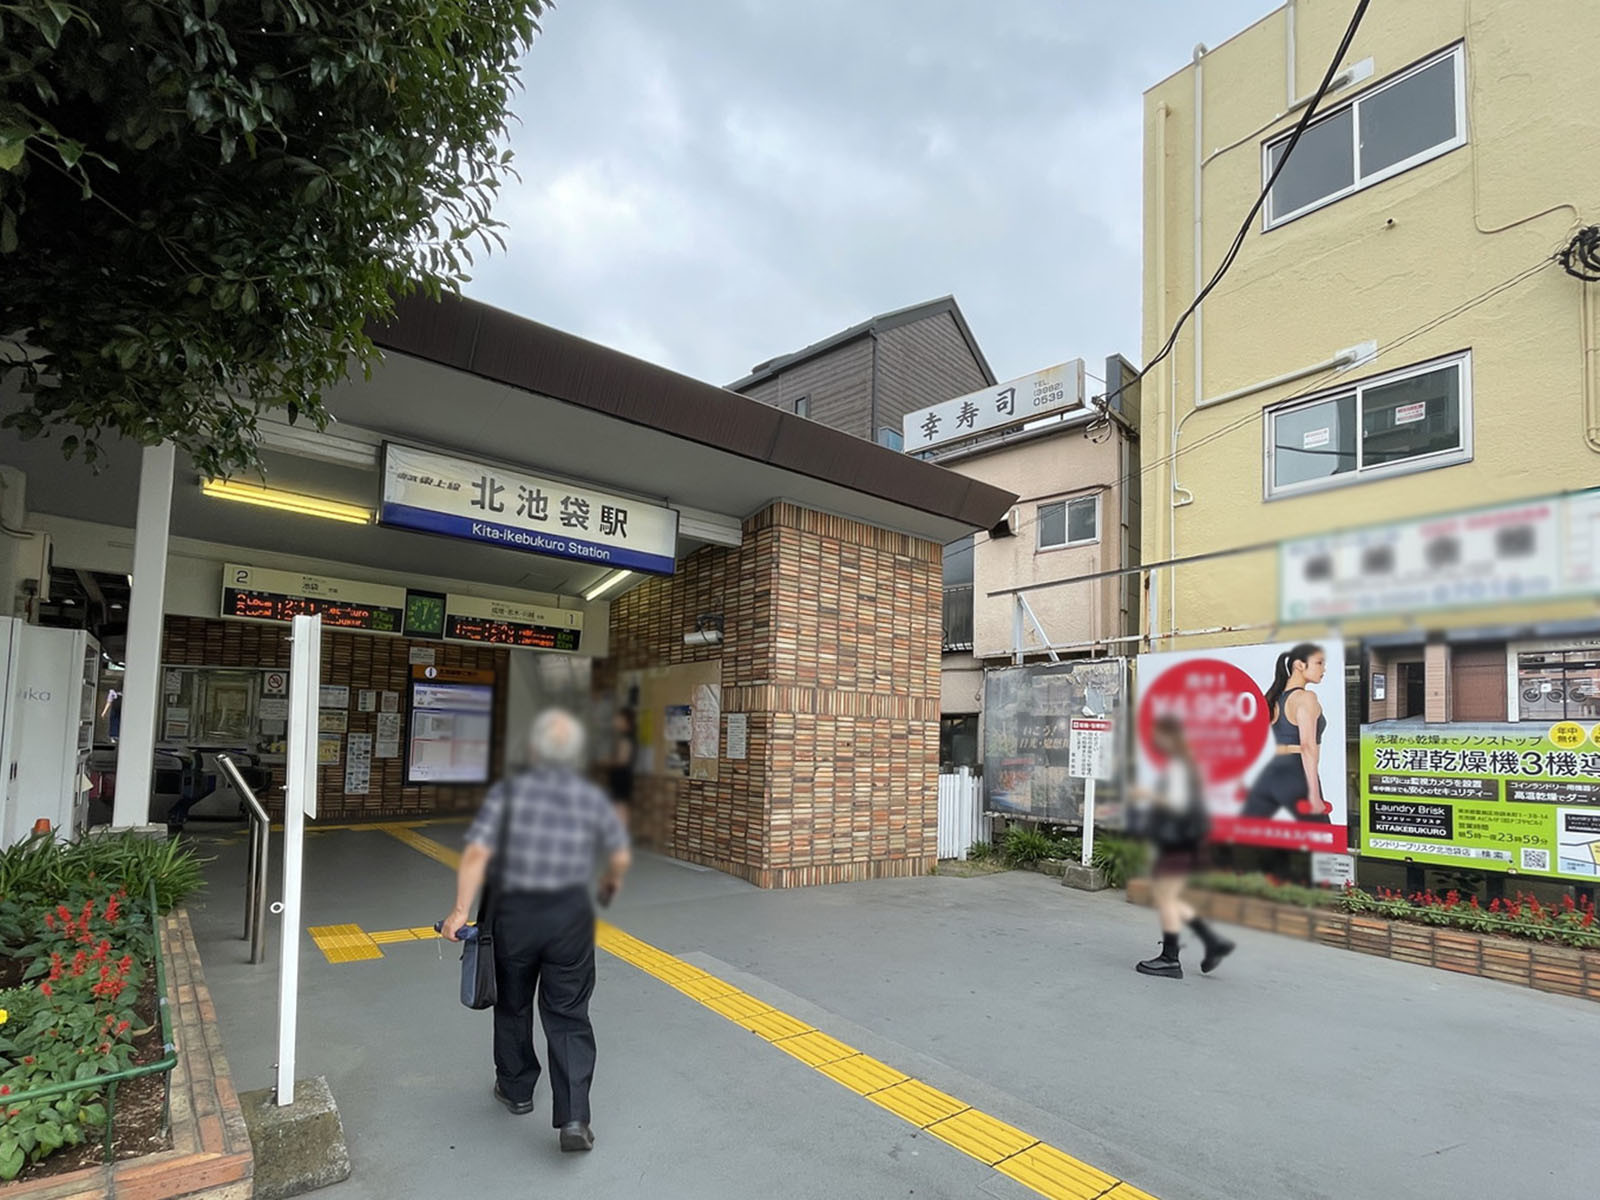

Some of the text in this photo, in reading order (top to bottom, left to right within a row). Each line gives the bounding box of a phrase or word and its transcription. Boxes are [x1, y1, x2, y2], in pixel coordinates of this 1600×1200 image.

[1033, 390, 1064, 407] 0539
[920, 387, 1017, 441] 幸寿司
[470, 475, 628, 538] 北池袋駅
[472, 523, 610, 560] Kita-ikebukuro Station
[236, 570, 249, 584] 2
[568, 614, 575, 625] 1
[1375, 803, 1446, 815] Laundry Brisk
[1375, 824, 1447, 836] KITAIKEBUKURO
